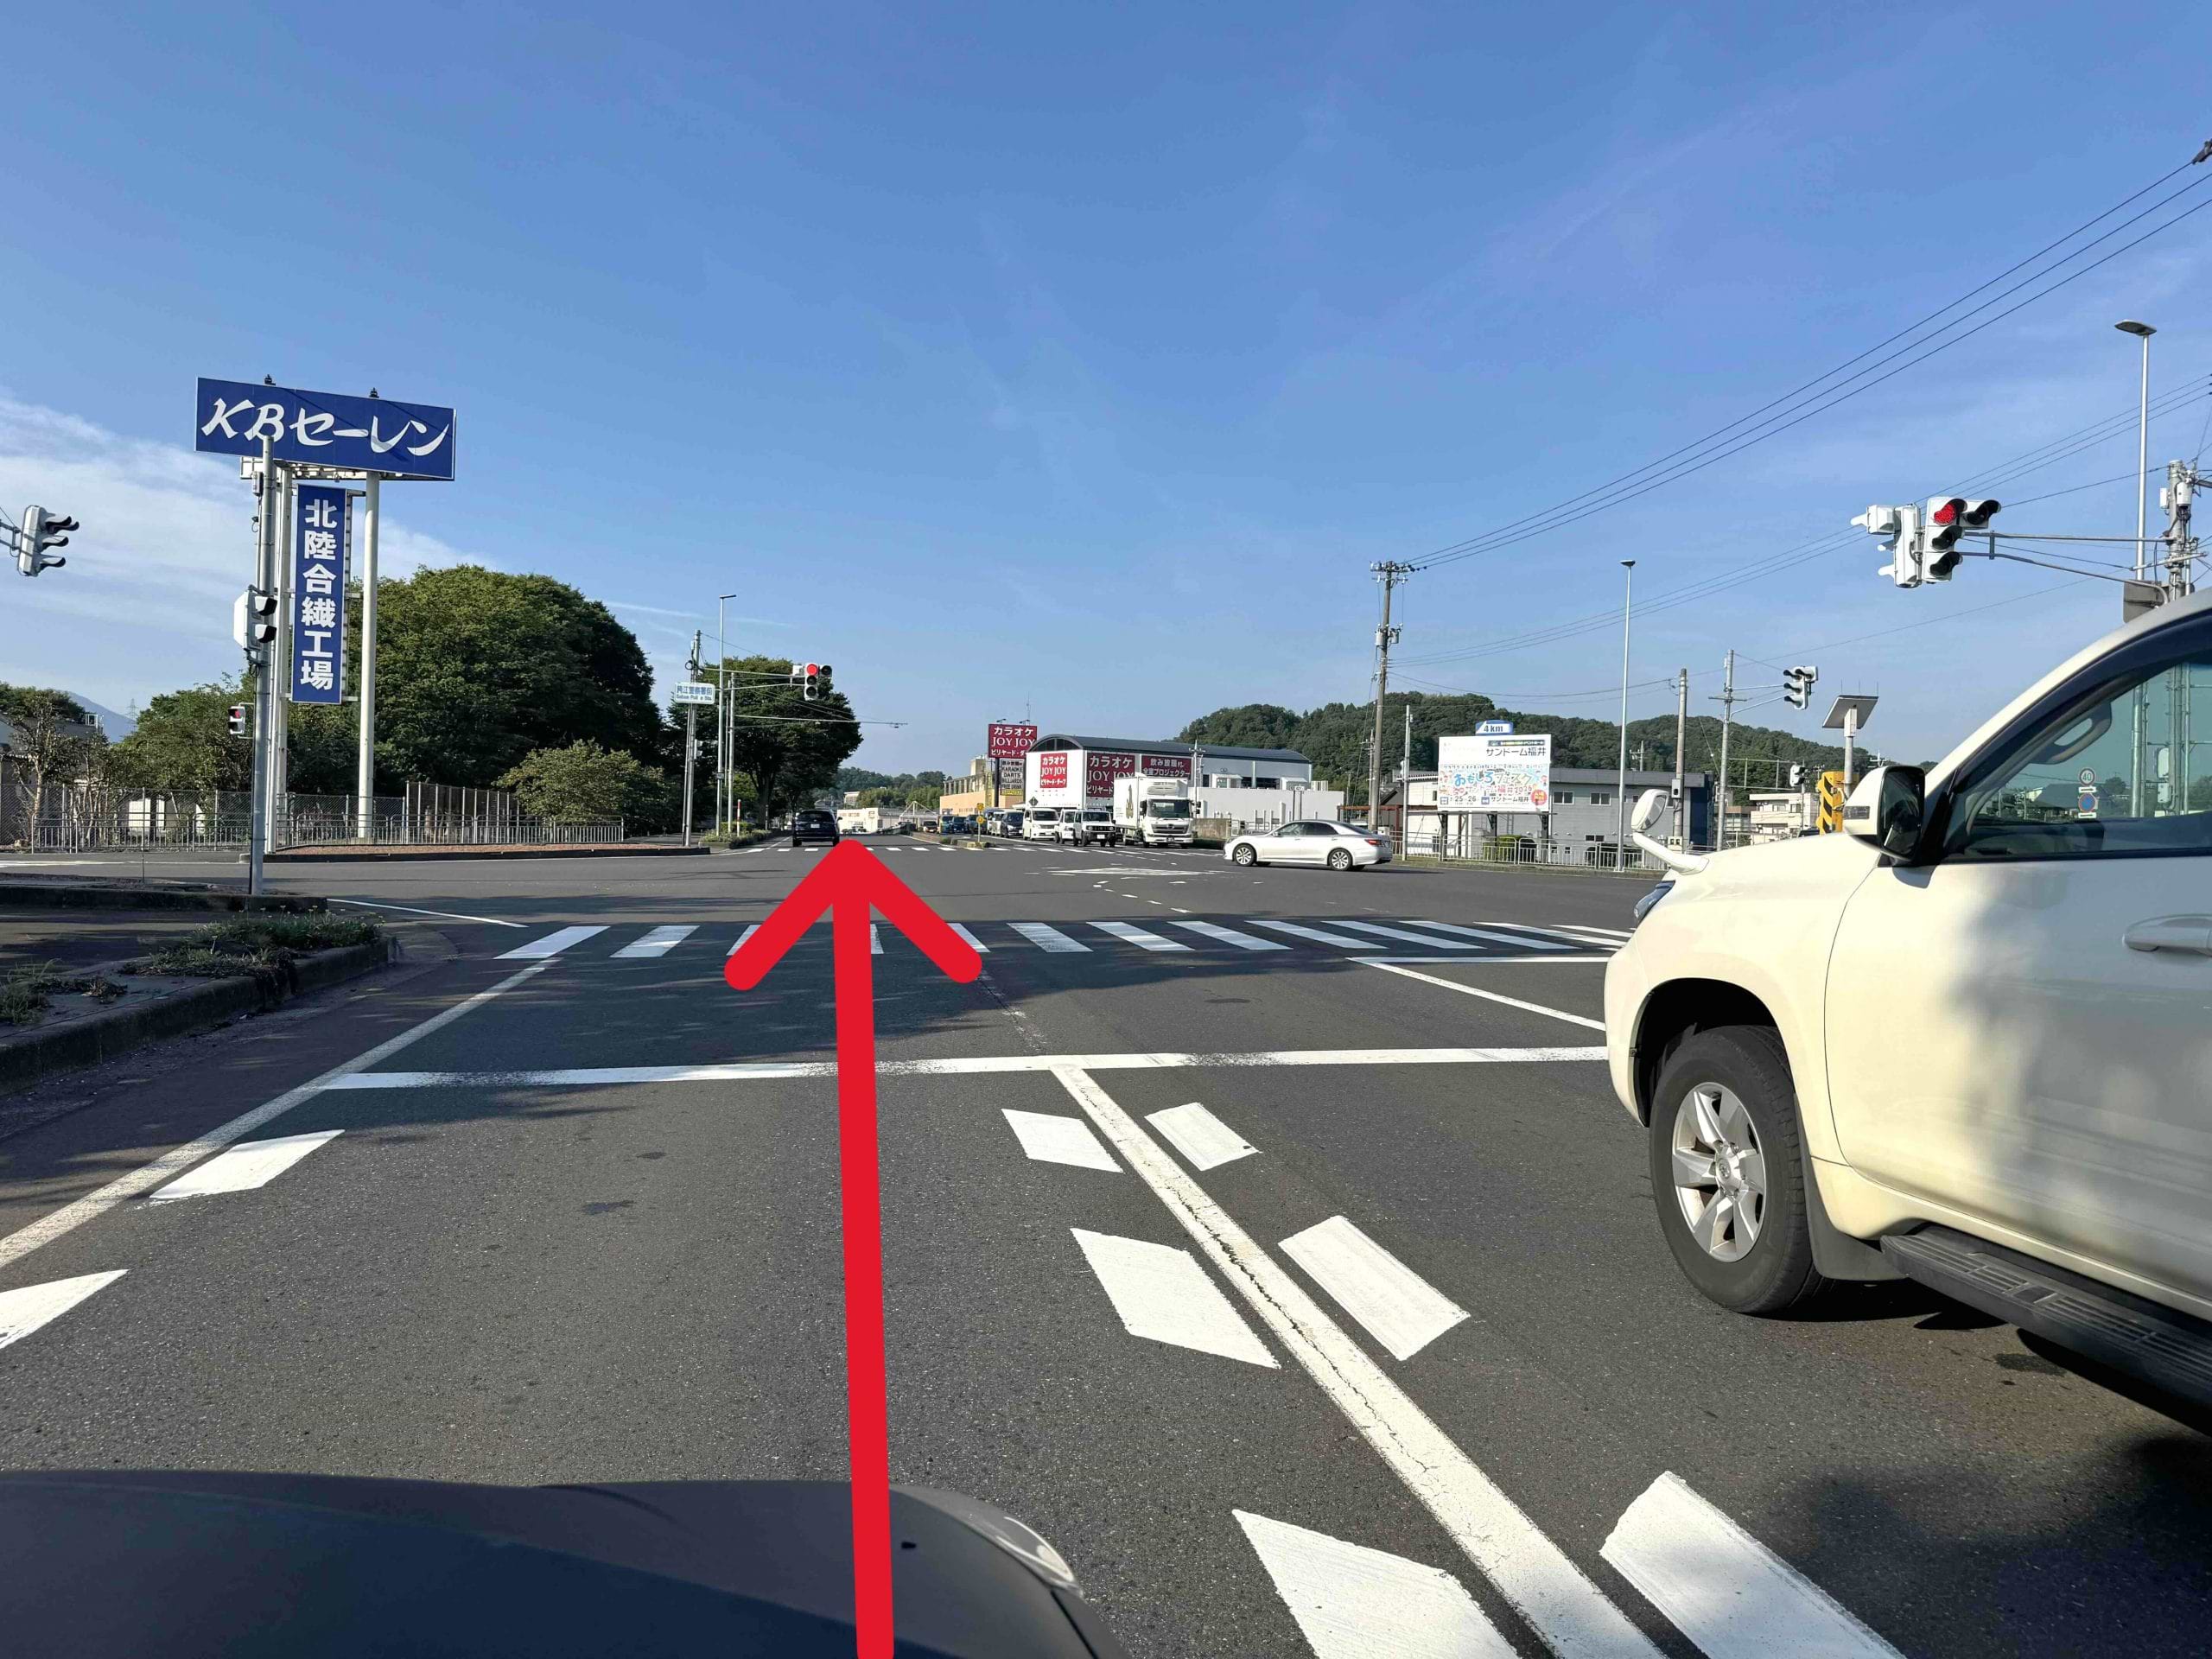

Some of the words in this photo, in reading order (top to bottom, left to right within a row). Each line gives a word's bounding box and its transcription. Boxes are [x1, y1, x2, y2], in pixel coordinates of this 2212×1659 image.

[200, 397, 449, 456] KBセーレン
[994, 727, 1034, 736] カラオケ
[992, 737, 1013, 747] JOY
[1014, 738, 1036, 748] JOY
[1486, 747, 1547, 757] サンドーム福井
[1042, 756, 1066, 766] カラオケ
[1090, 755, 1133, 769] カラオケ
[1041, 766, 1053, 777] JOY
[1053, 766, 1066, 777] JOY
[1088, 770, 1110, 783] JOY
[2082, 772, 2092, 781] 40
